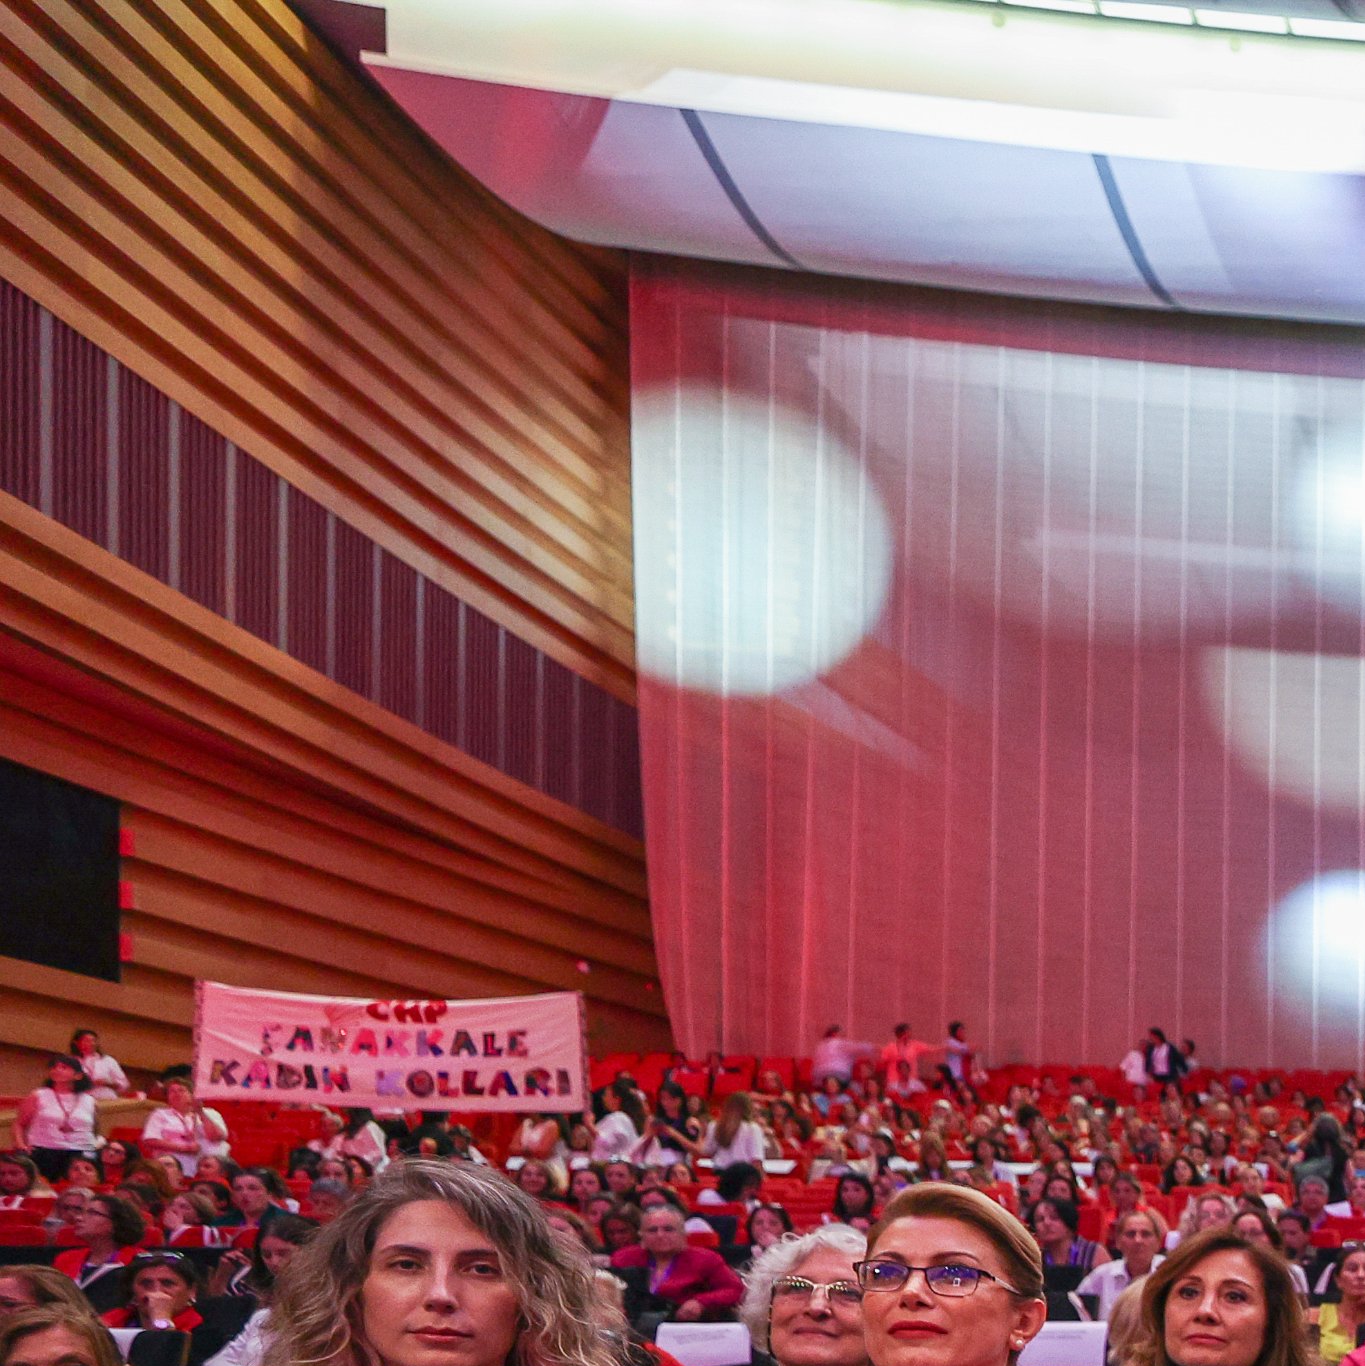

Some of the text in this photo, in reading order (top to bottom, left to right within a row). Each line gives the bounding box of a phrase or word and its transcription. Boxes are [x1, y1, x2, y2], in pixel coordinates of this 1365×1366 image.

[366, 1000, 447, 1023] CHP
[210, 1060, 571, 1098] KADIN KOLLARI
